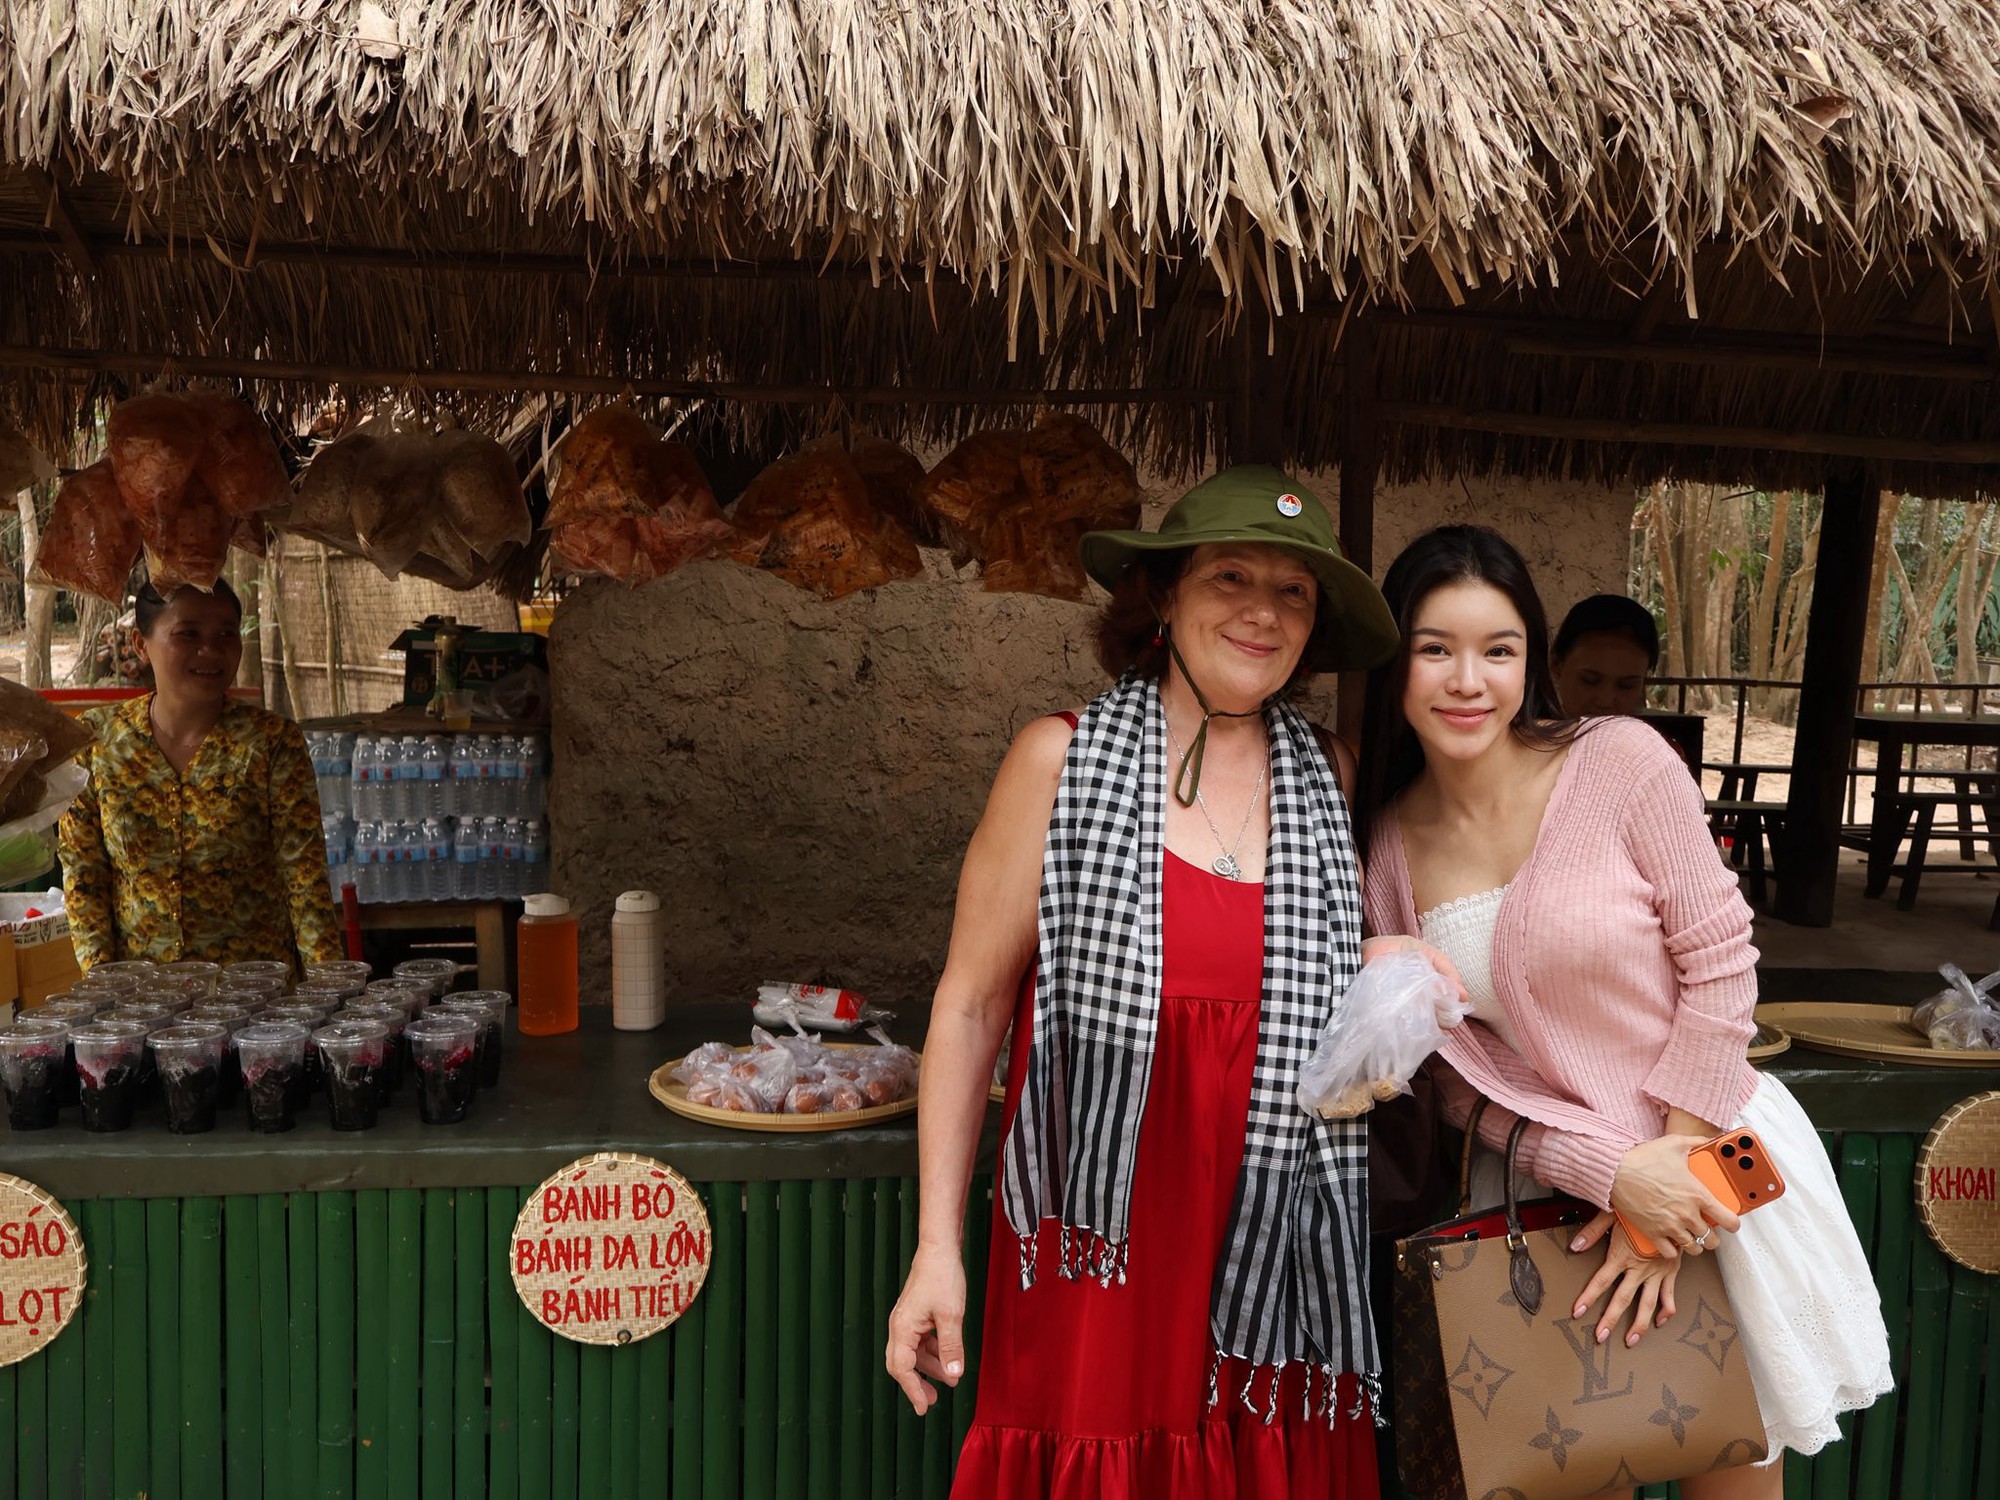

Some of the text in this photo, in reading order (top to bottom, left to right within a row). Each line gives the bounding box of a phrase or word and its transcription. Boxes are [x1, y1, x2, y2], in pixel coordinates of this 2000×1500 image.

[543, 1171, 675, 1223] BÁNH BÒ
[1930, 1167, 1996, 1200] KHOAI
[0, 1205, 66, 1259] SÁO
[516, 1227, 592, 1275] BÁNH
[603, 1234, 638, 1270] DA
[0, 1287, 69, 1336] LỌT
[542, 1273, 693, 1325] BÁNH TIÊU
